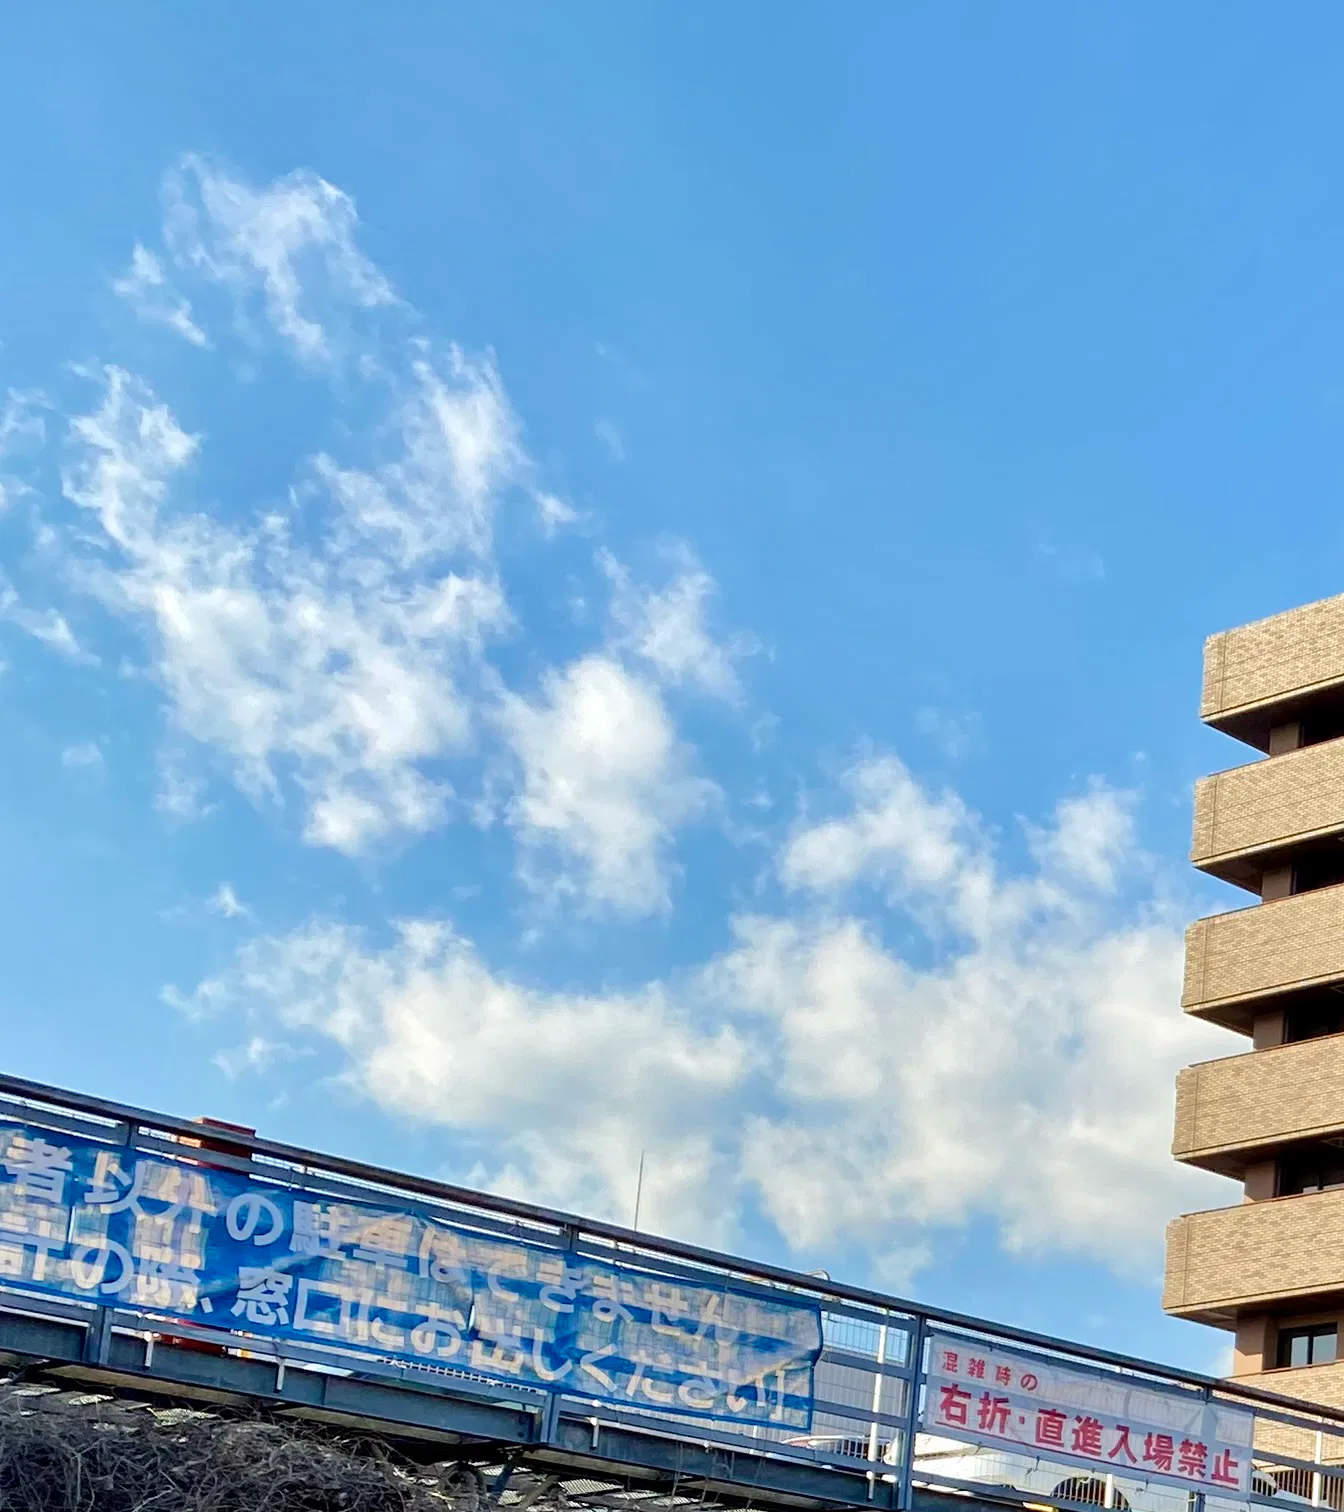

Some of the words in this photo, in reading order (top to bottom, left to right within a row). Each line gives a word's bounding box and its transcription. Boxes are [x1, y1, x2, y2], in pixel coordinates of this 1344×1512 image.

[942, 1349, 1039, 1392] 混雑時の
[939, 1383, 1240, 1486] 右折・直進入場禁止
